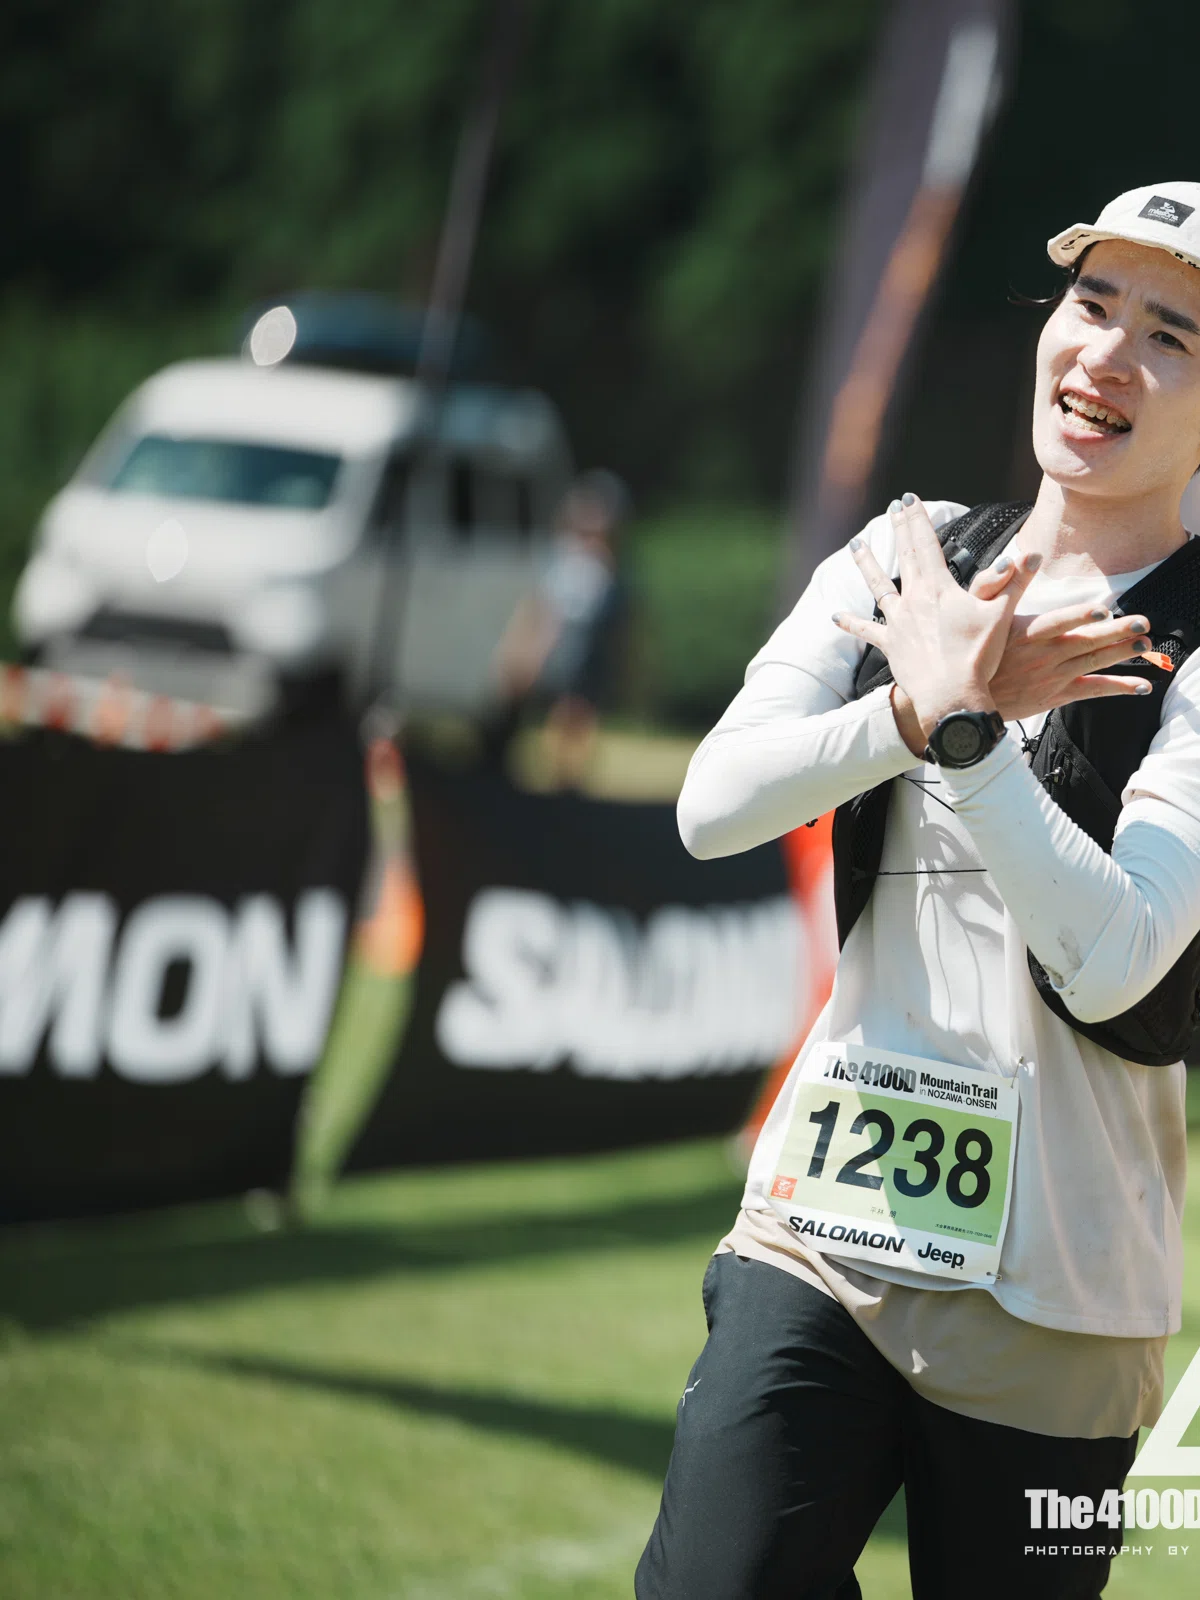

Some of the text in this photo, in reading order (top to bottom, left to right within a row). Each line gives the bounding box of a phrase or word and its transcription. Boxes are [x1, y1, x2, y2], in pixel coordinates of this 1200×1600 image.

[823, 1055, 917, 1094] The 4100D
[920, 1072, 998, 1100] Mountain Trail
[919, 1086, 998, 1110] in NOZAWA-ONSEN
[807, 1100, 993, 1209] 1238
[789, 1215, 906, 1253] SALOMON
[917, 1242, 966, 1271] Jeep
